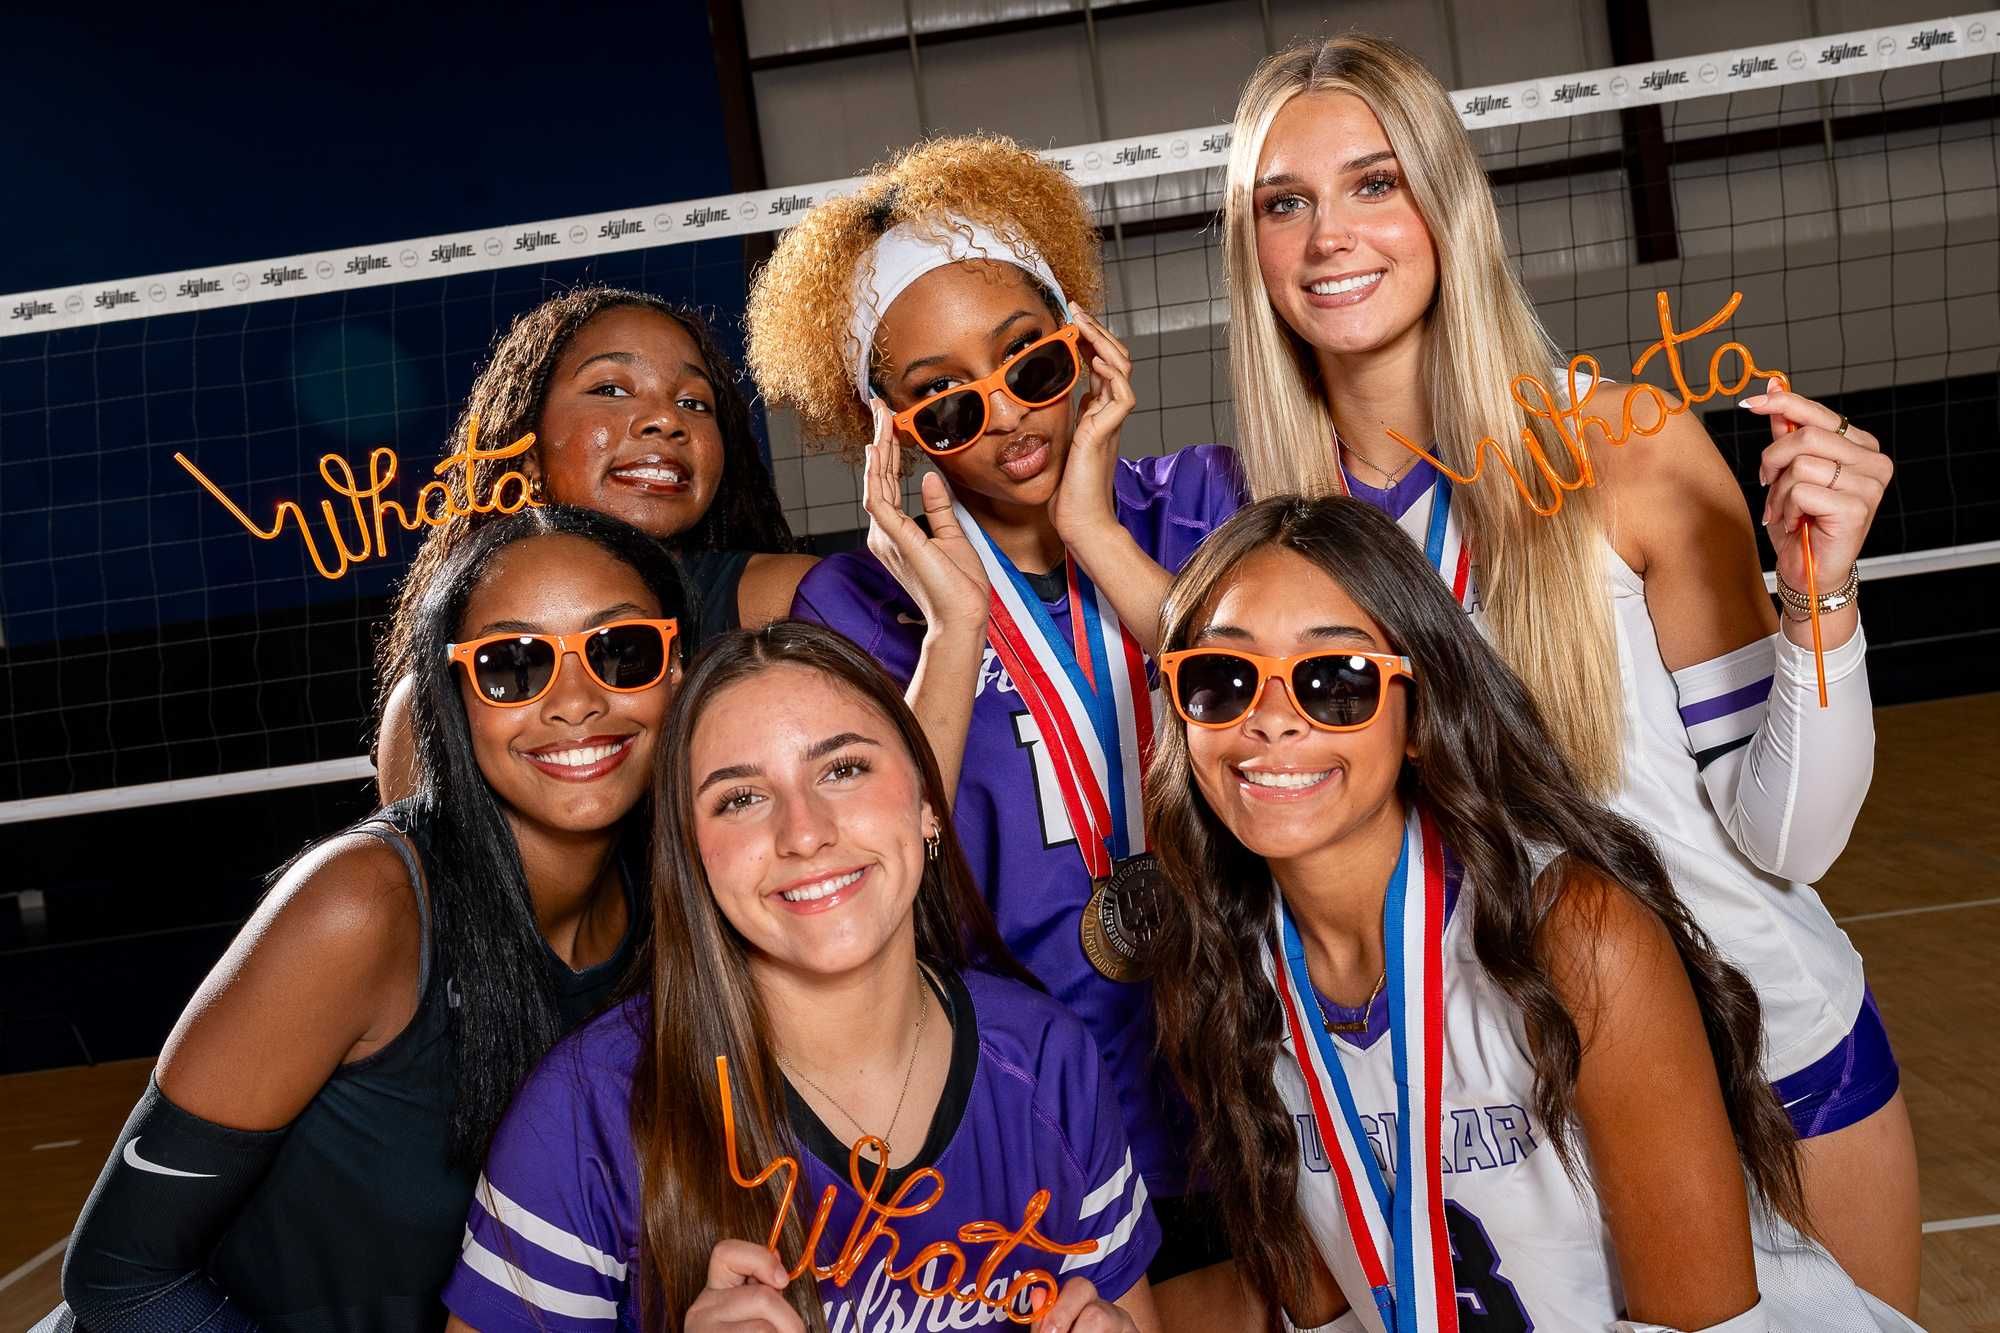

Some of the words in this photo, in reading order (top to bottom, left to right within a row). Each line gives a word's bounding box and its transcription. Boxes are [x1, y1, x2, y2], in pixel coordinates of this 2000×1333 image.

[185, 413, 541, 580] Whata
[1400, 291, 1792, 517] Whata
[725, 1090, 1099, 1325] Whata
